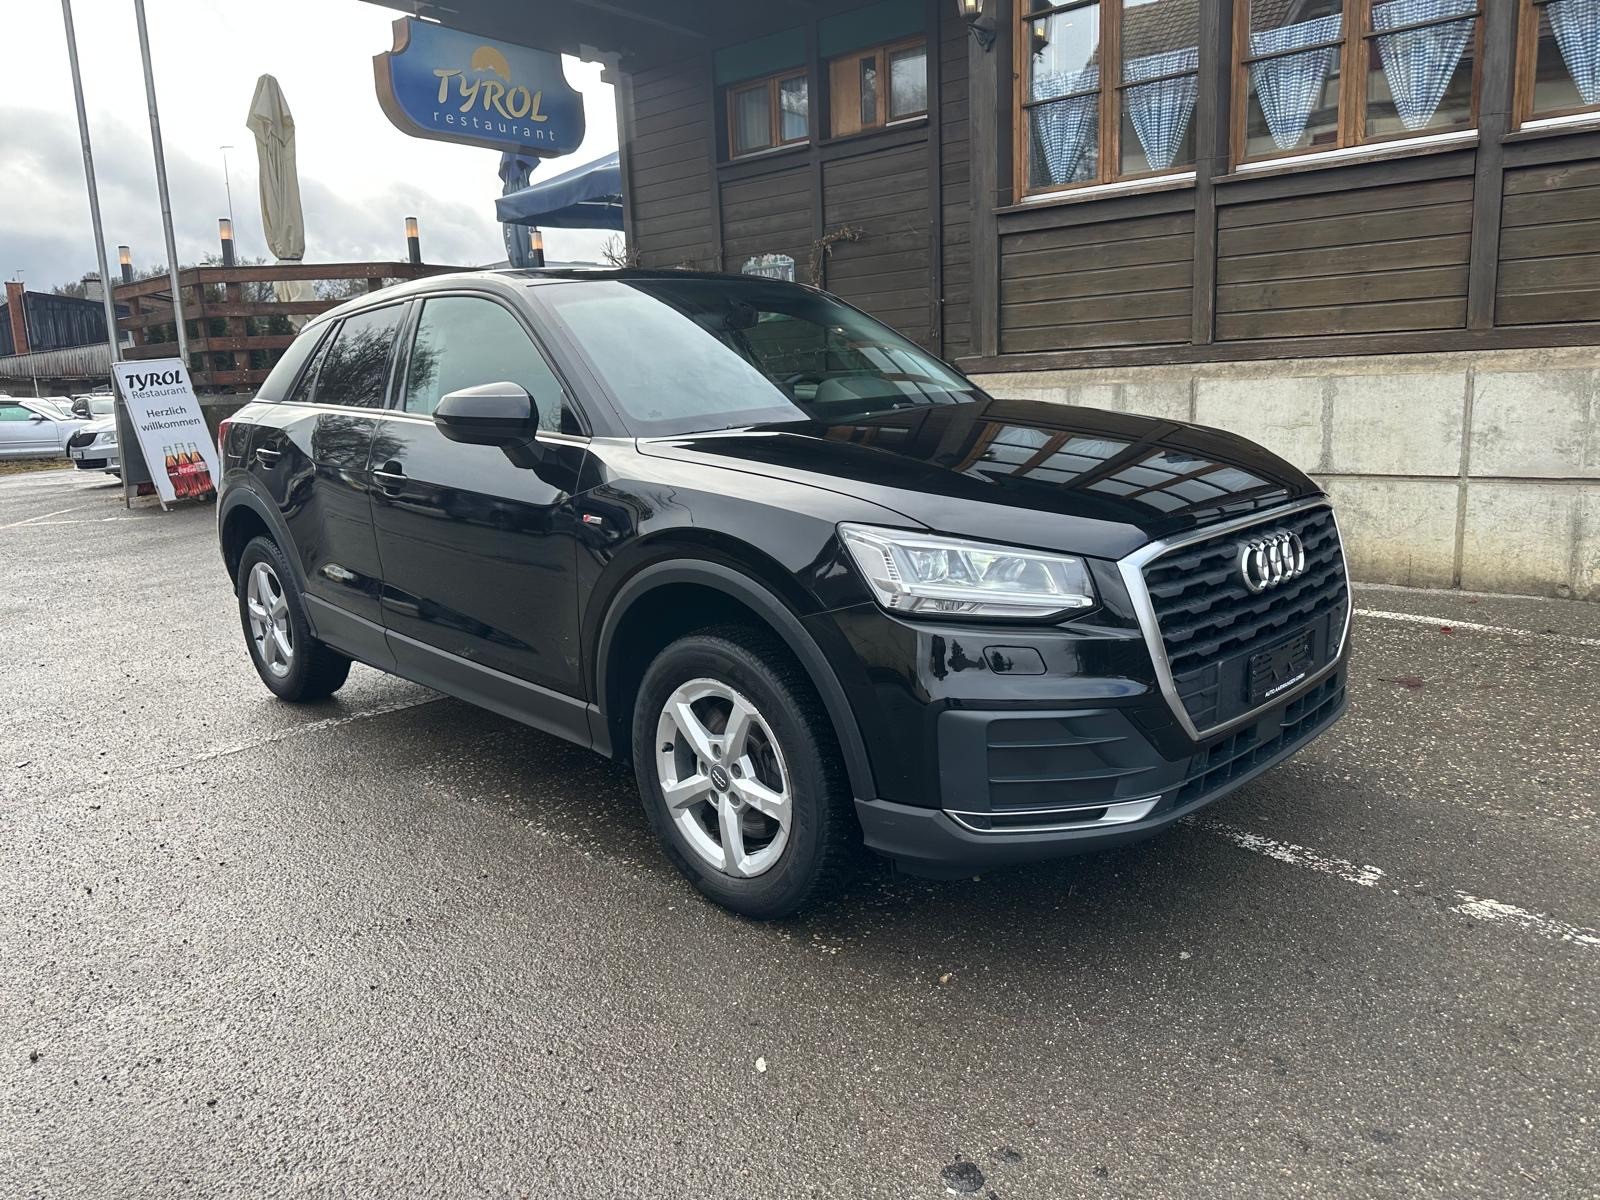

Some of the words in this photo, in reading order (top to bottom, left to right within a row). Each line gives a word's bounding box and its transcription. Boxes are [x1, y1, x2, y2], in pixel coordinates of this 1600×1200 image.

[433, 69, 548, 122] TYROL
[433, 111, 556, 142] restaurant
[125, 370, 183, 391] TYROL
[132, 387, 188, 400] Restaurant
[146, 406, 187, 418] Herzlich
[141, 418, 201, 432] willkommen
